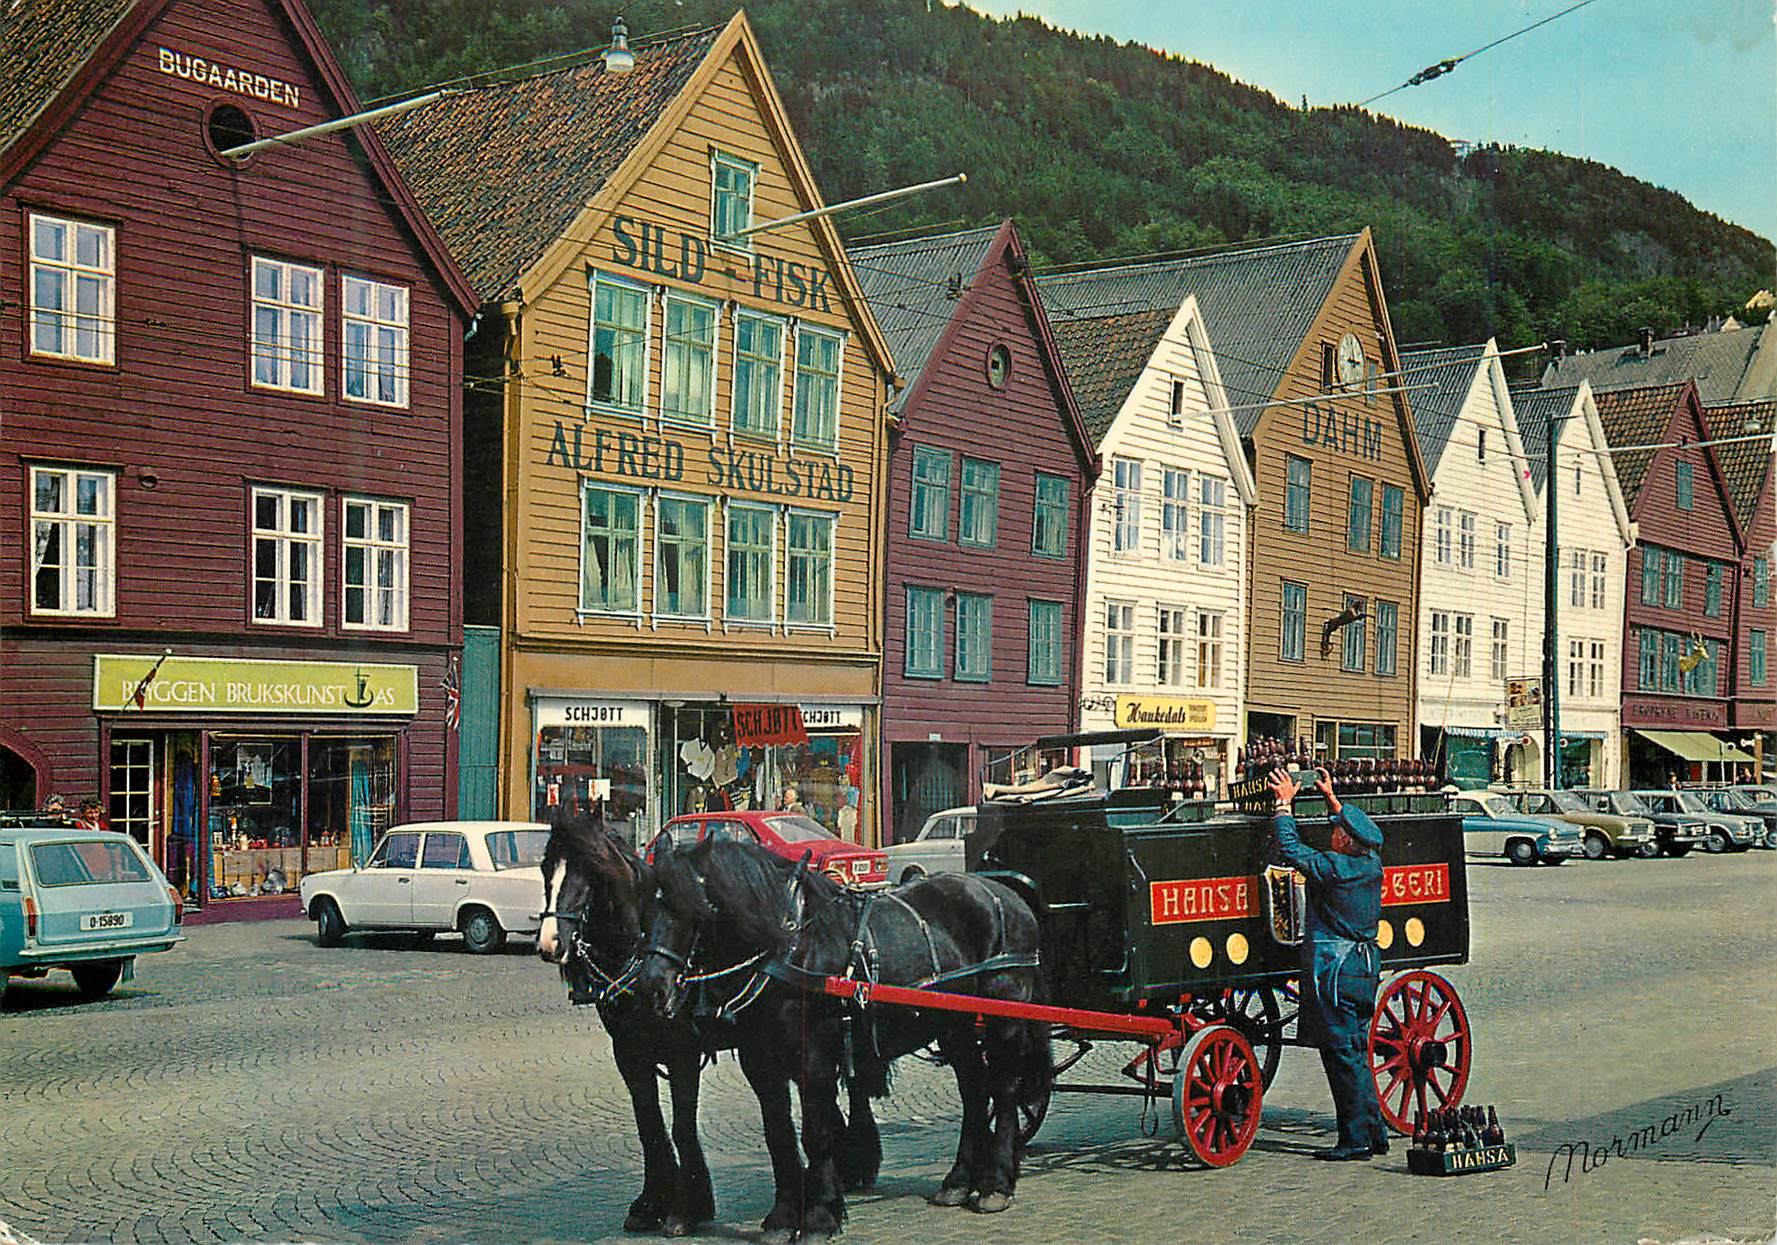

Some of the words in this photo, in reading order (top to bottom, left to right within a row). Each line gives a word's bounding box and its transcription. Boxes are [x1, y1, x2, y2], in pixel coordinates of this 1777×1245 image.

[158, 47, 300, 108] BUGAARDEN
[612, 216, 707, 285] SILD
[752, 254, 834, 314] FISK
[1304, 405, 1382, 461] DAHM
[547, 421, 685, 482] ALFRED
[707, 446, 855, 503] SKULSTAD
[227, 683, 347, 705] BRUKSKUNST
[373, 688, 396, 706] AS
[565, 707, 624, 722] SCHJØTT
[737, 706, 799, 737] SCHJØTT
[801, 710, 841, 724] CHJØTT
[1127, 702, 1186, 724] Haukedals
[1162, 883, 1249, 916] HANSA
[1452, 1146, 1509, 1170] HANSA
